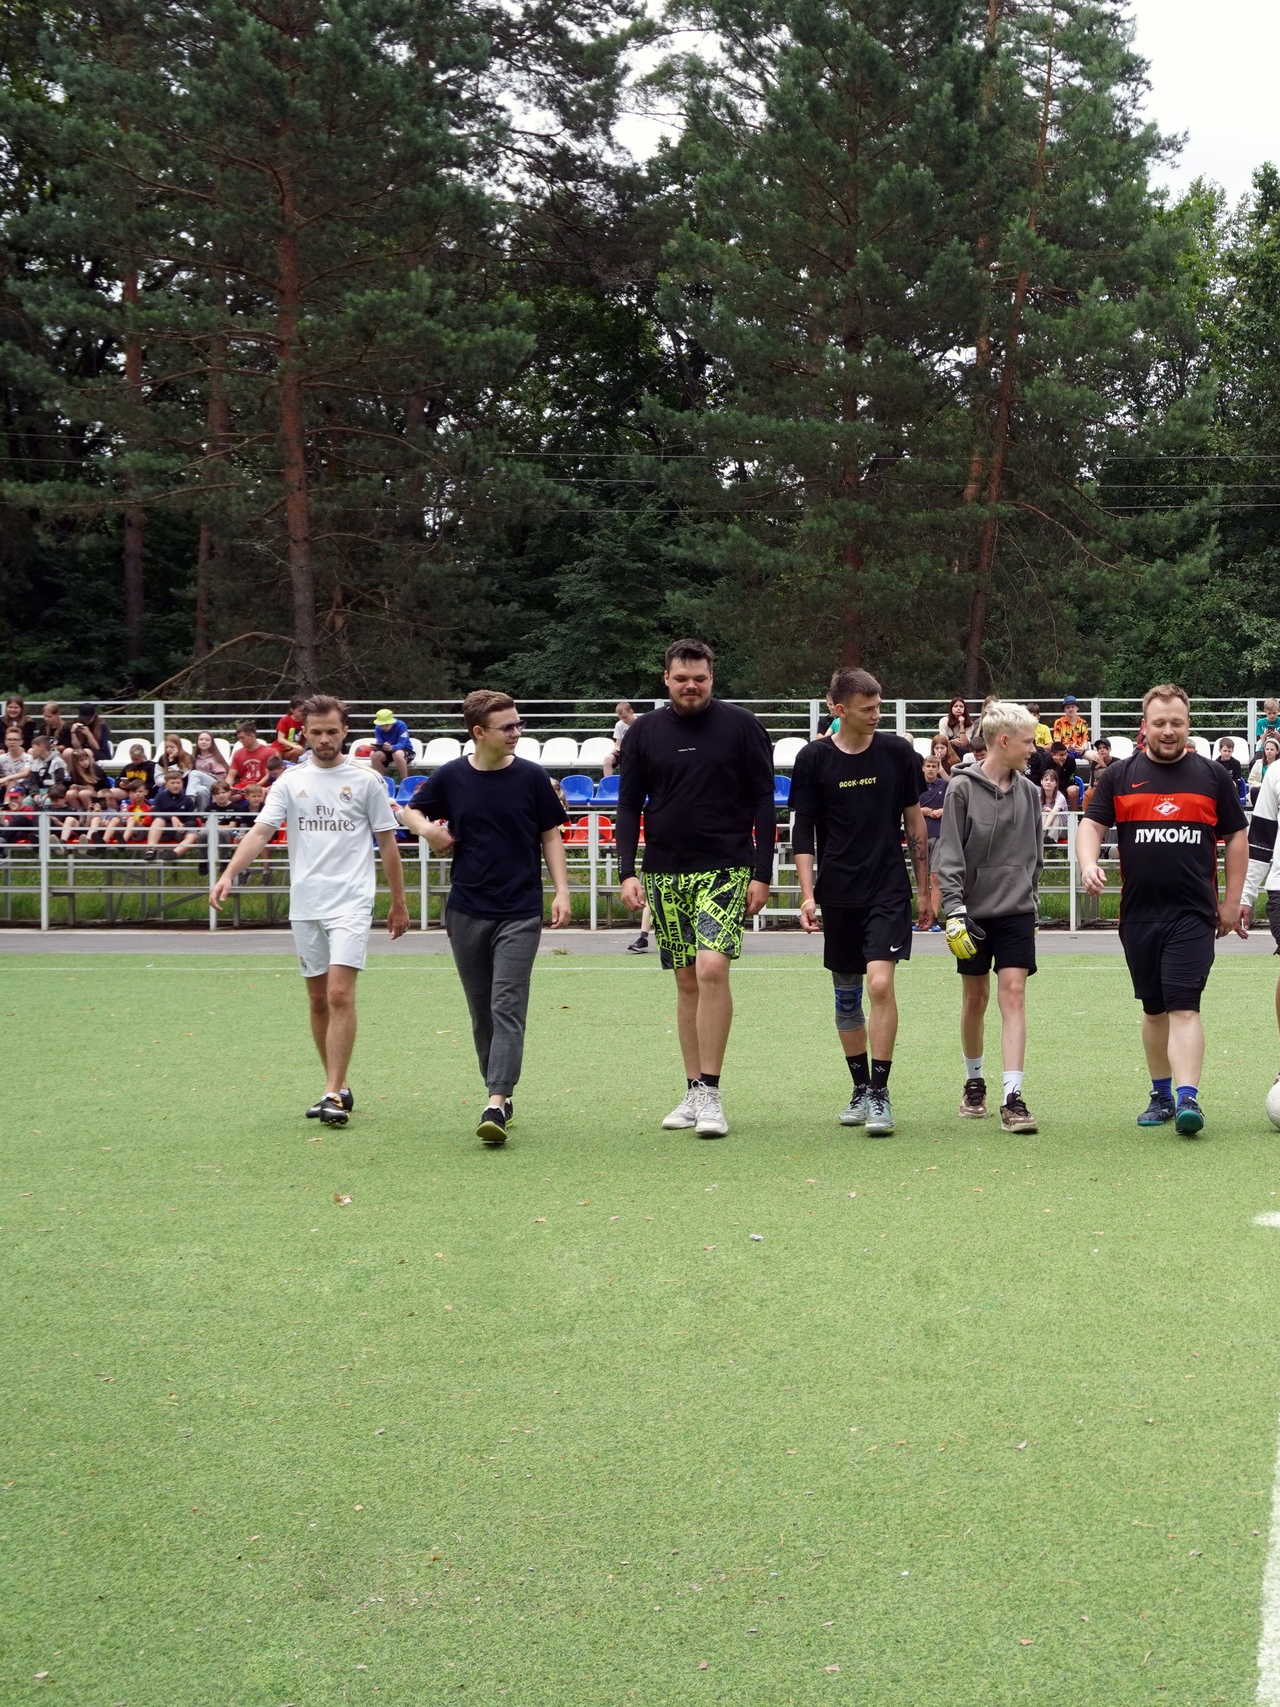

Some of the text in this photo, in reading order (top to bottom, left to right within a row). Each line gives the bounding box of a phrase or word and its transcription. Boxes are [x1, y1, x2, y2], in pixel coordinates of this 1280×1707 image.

[316, 805, 335, 818] Fly
[298, 816, 356, 832] Emirates
[1134, 826, 1202, 844] ЛУКОЙЛ
[660, 940, 690, 954] READY
